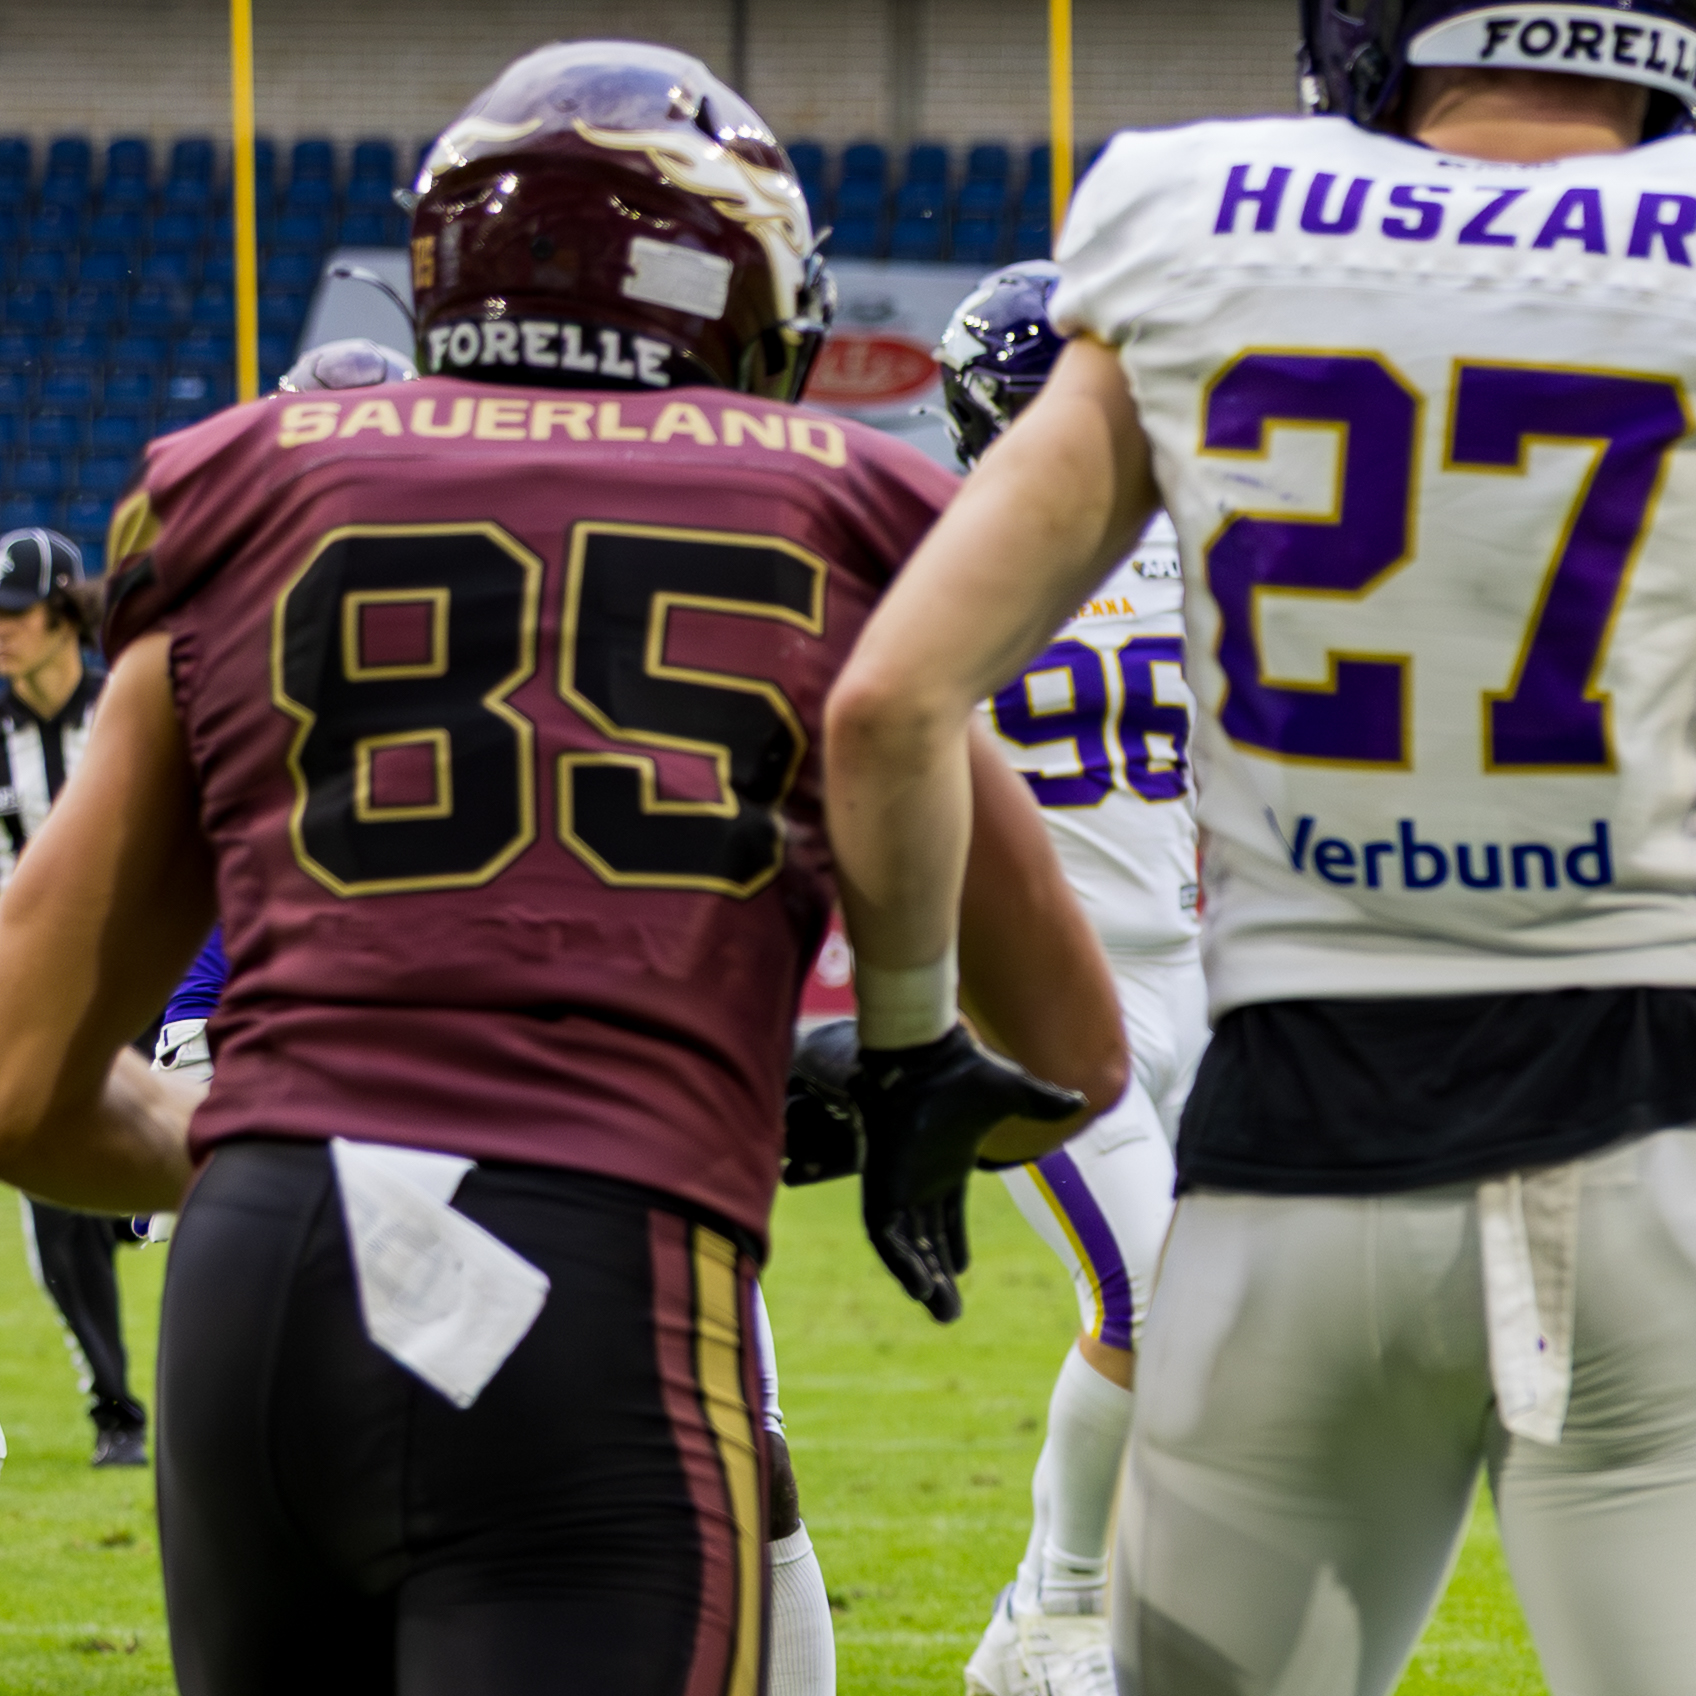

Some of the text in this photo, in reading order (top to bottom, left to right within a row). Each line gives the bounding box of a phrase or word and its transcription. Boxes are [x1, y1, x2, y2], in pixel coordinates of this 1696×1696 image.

[279, 397, 847, 468] SAUERLAND
[428, 320, 672, 388] FORELLE
[1198, 346, 1696, 774] 27
[272, 519, 828, 896] 85
[990, 634, 1189, 807] 96
